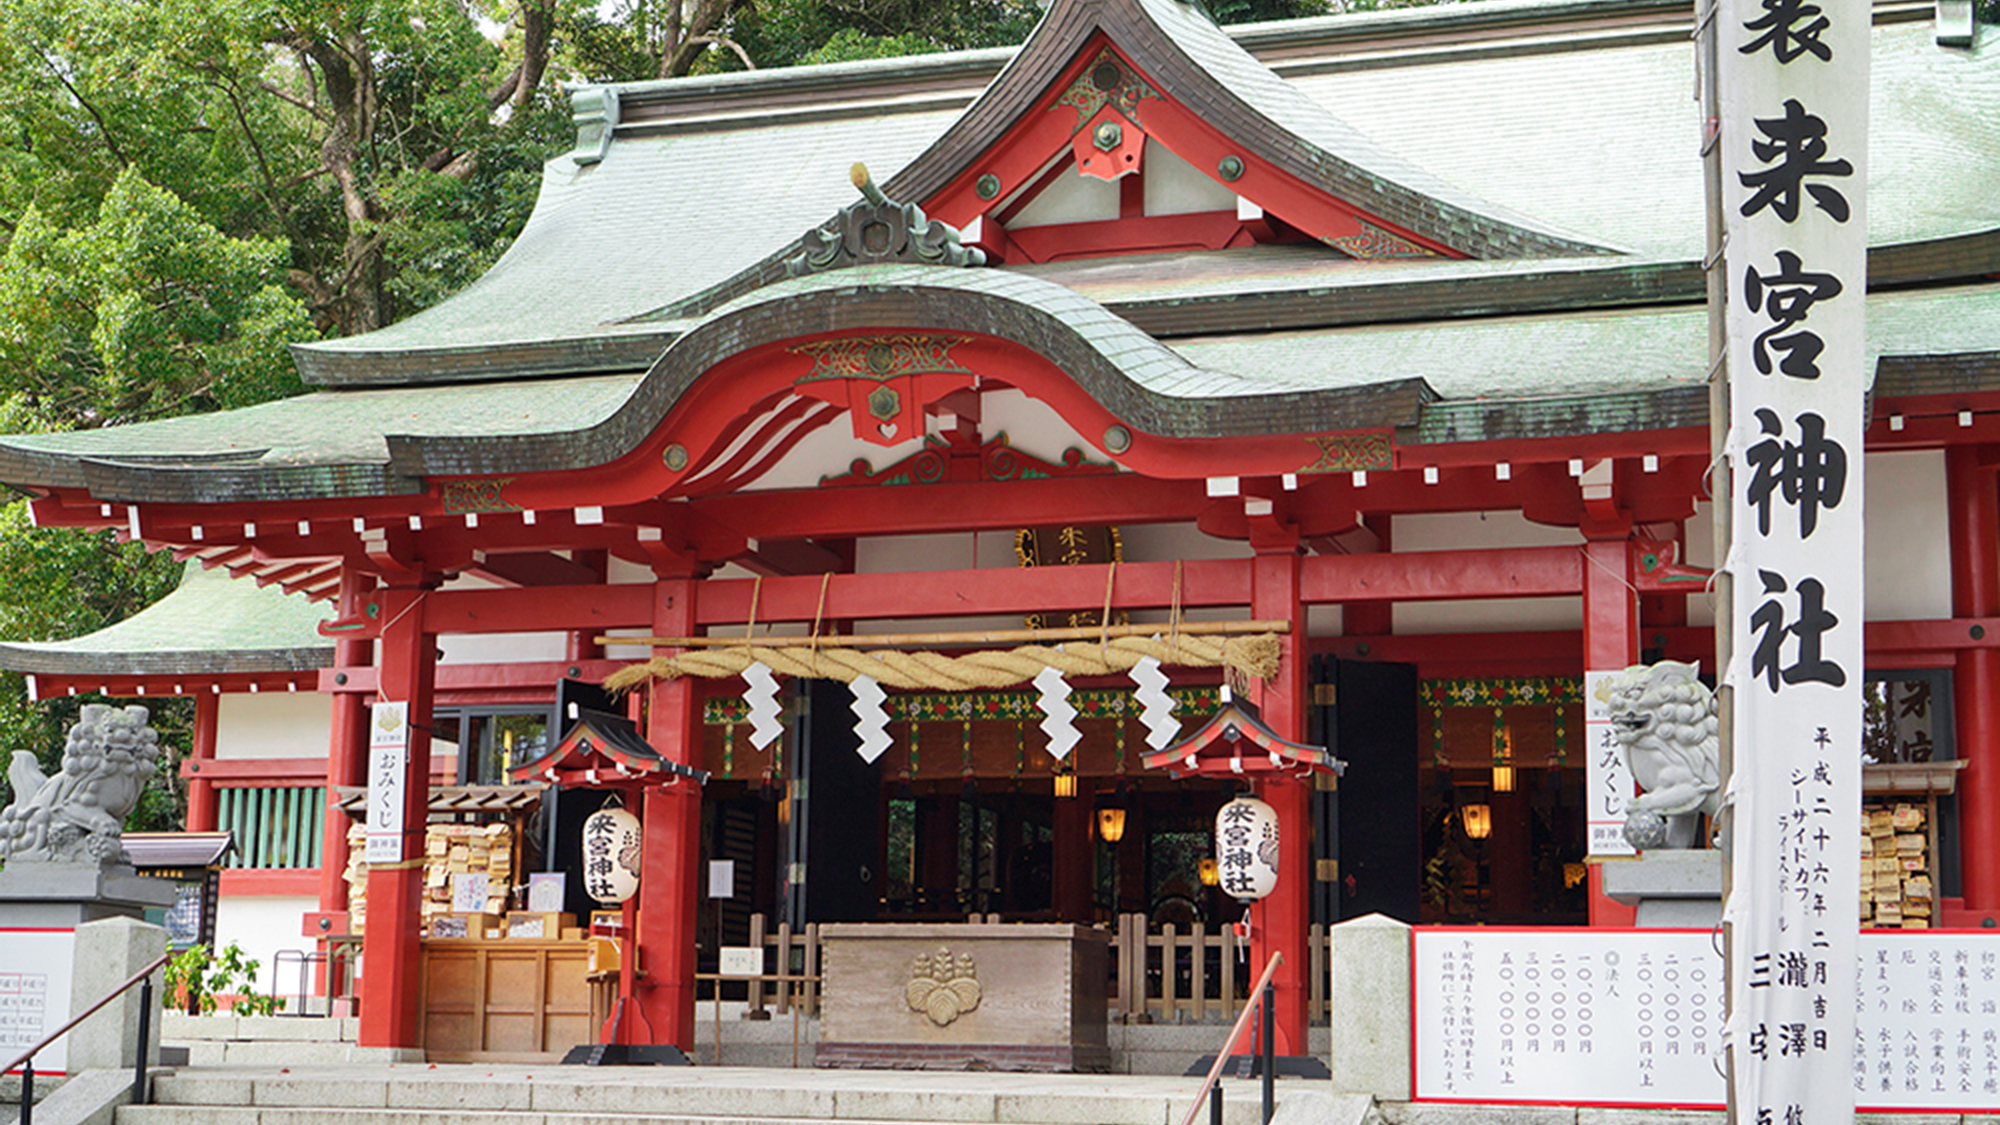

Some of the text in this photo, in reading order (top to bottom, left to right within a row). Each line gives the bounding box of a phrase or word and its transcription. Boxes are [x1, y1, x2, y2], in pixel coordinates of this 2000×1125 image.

[378, 753, 397, 829] おみくじ
[1600, 729, 1623, 816] おみくじ
[1811, 726, 1833, 1051] 平成二十六年二月吉日
[1876, 949, 1891, 1013] 星まつり
[1928, 950, 1946, 1093] 交通安全 学業向上
[1903, 1030, 1920, 1092] 入試合格
[1956, 1028, 1972, 1093] 手術安全
